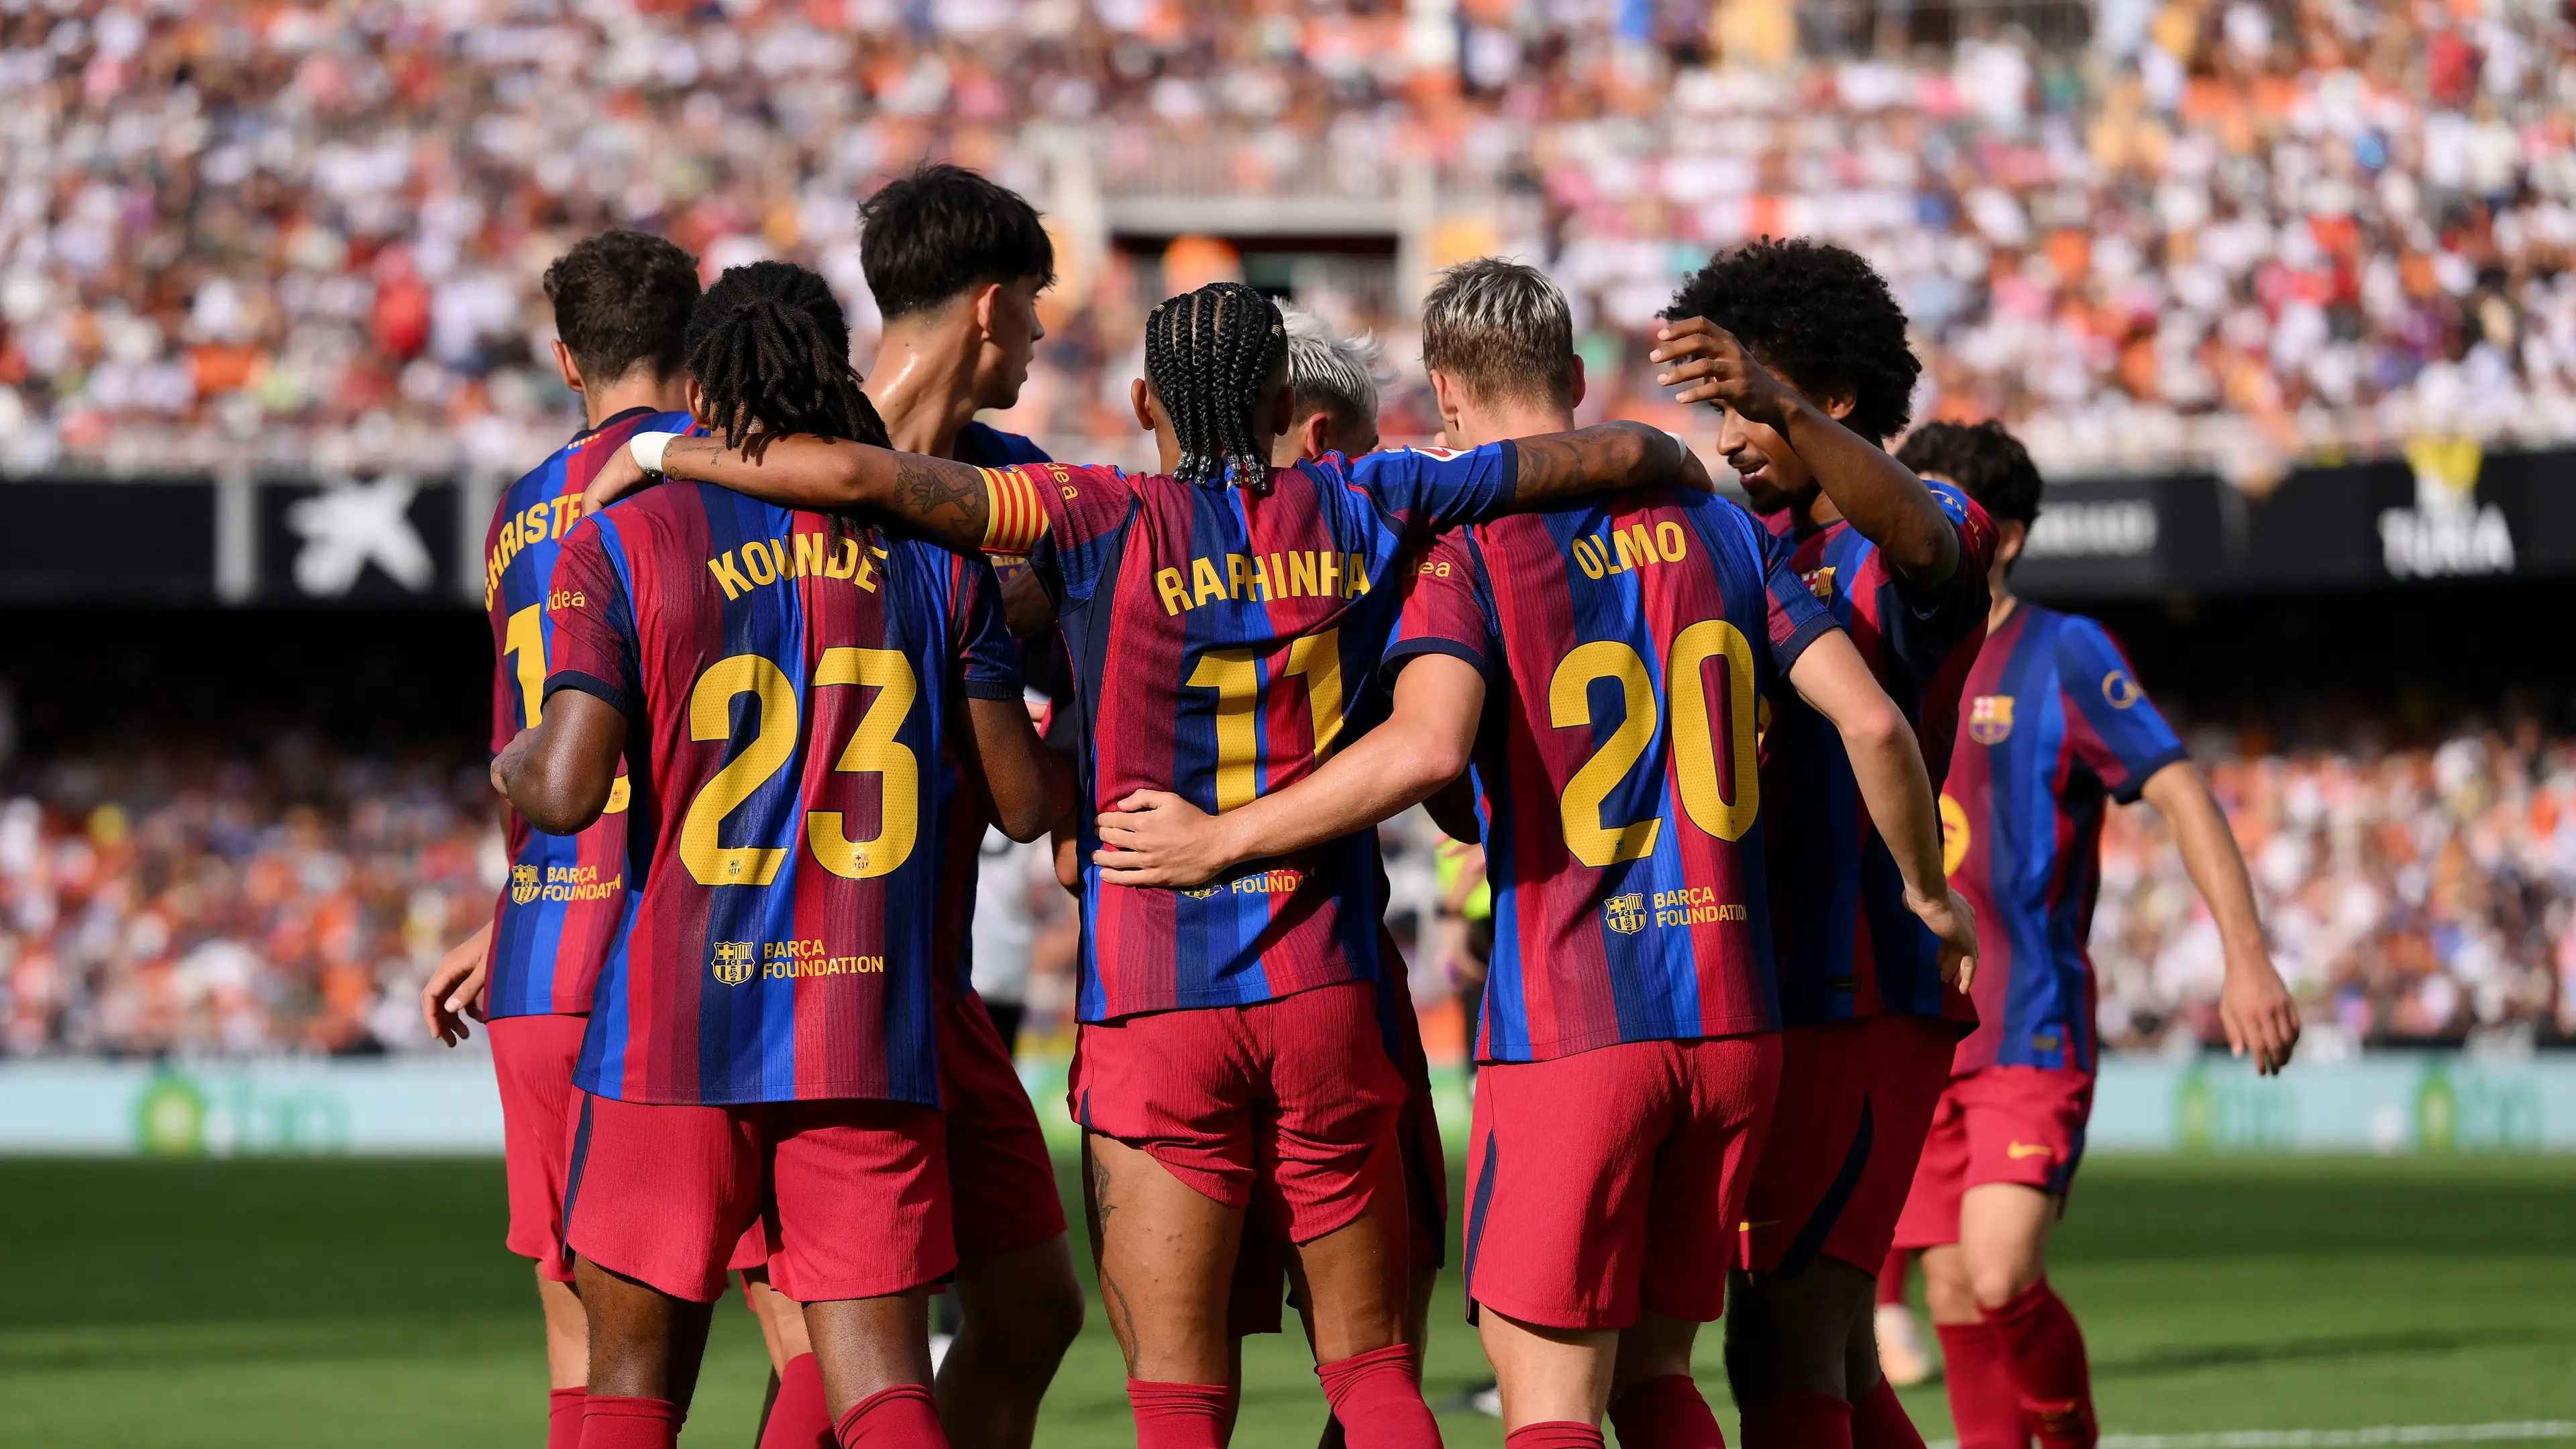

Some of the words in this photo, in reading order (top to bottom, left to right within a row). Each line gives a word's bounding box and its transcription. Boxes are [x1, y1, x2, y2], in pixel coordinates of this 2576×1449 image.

[1572, 521, 1686, 580] OLMO
[546, 586, 586, 613] idea
[1154, 550, 1371, 616] RAPHINHA
[1186, 627, 1344, 816] 11
[1549, 619, 1760, 868] 20
[678, 646, 918, 886] 23
[547, 865, 598, 885] BARÇA
[1653, 886, 1715, 909] BARÇA
[762, 955, 884, 980] FOUNDATION
[763, 939, 826, 960] BARÇA
